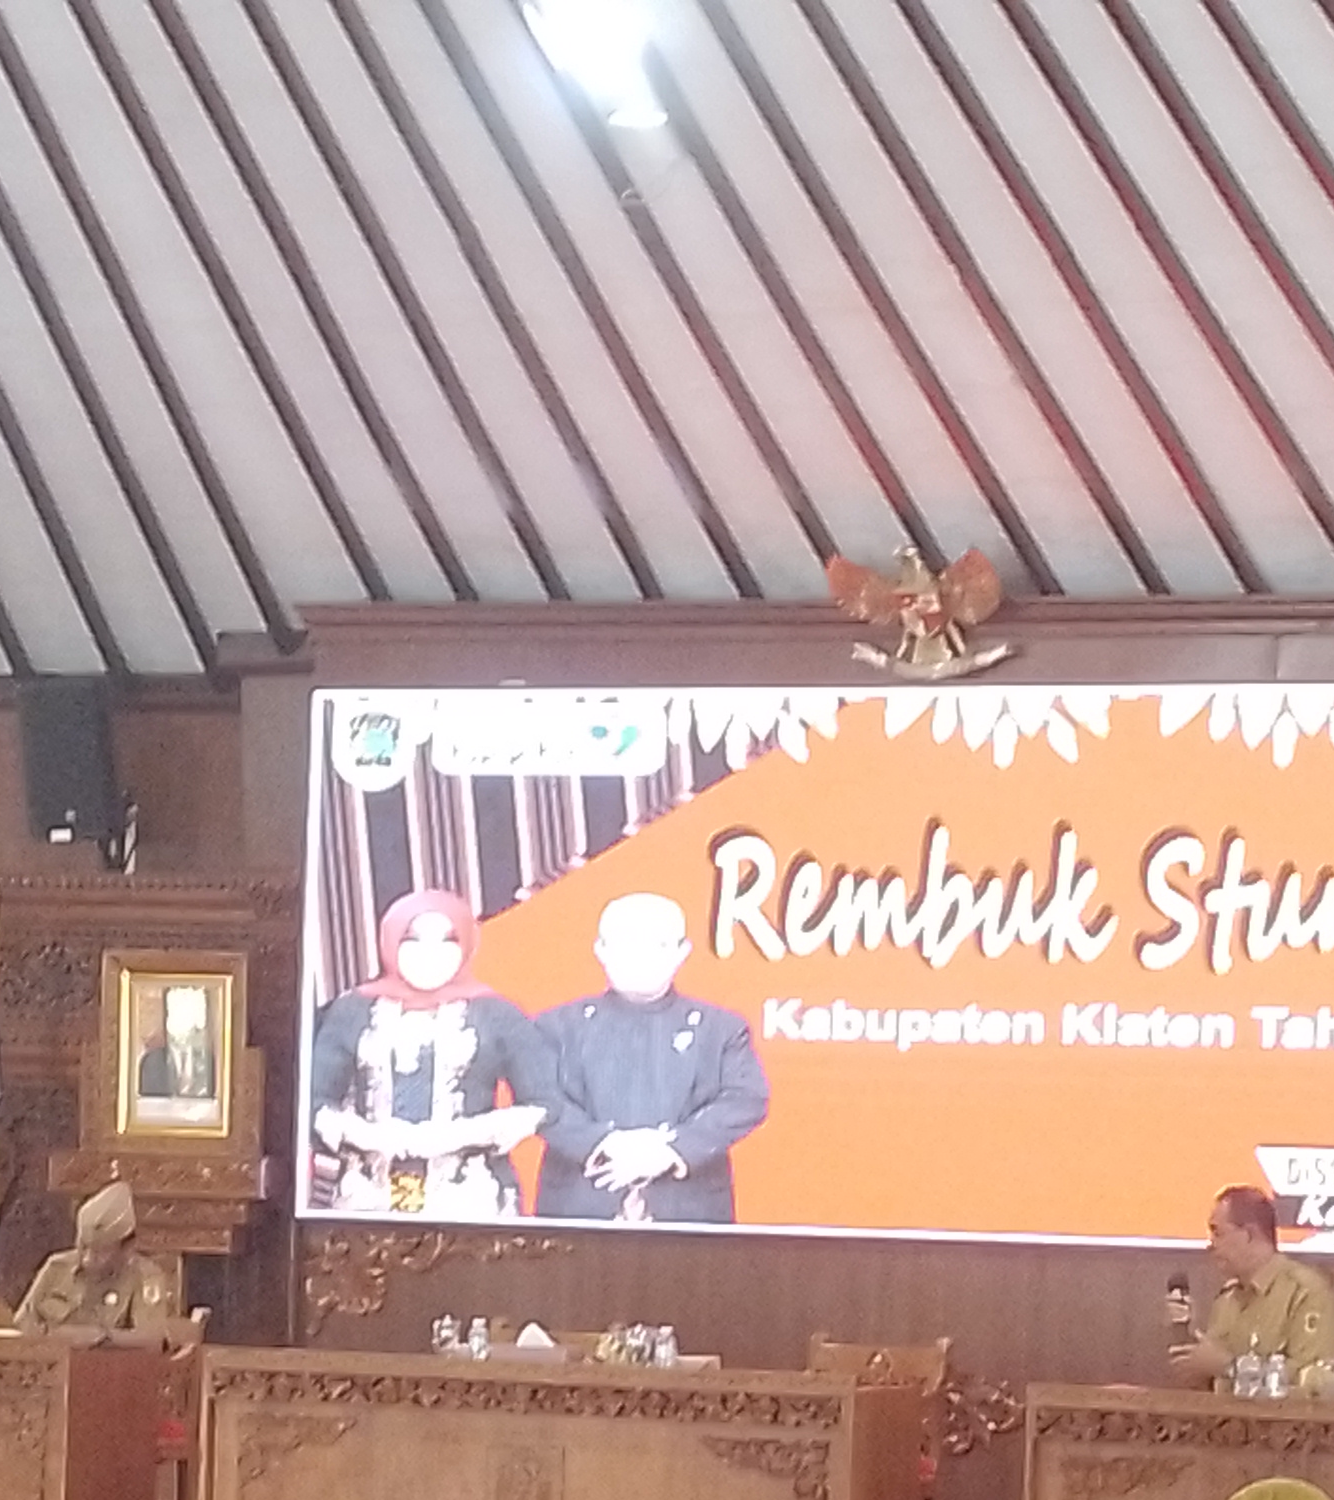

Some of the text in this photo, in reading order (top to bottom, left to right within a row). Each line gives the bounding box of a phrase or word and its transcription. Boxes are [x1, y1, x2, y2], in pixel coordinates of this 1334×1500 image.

[709, 816, 1119, 969] Rembuk
[763, 998, 1046, 1052] Kabupaten
[1060, 1002, 1236, 1048] Klaten
